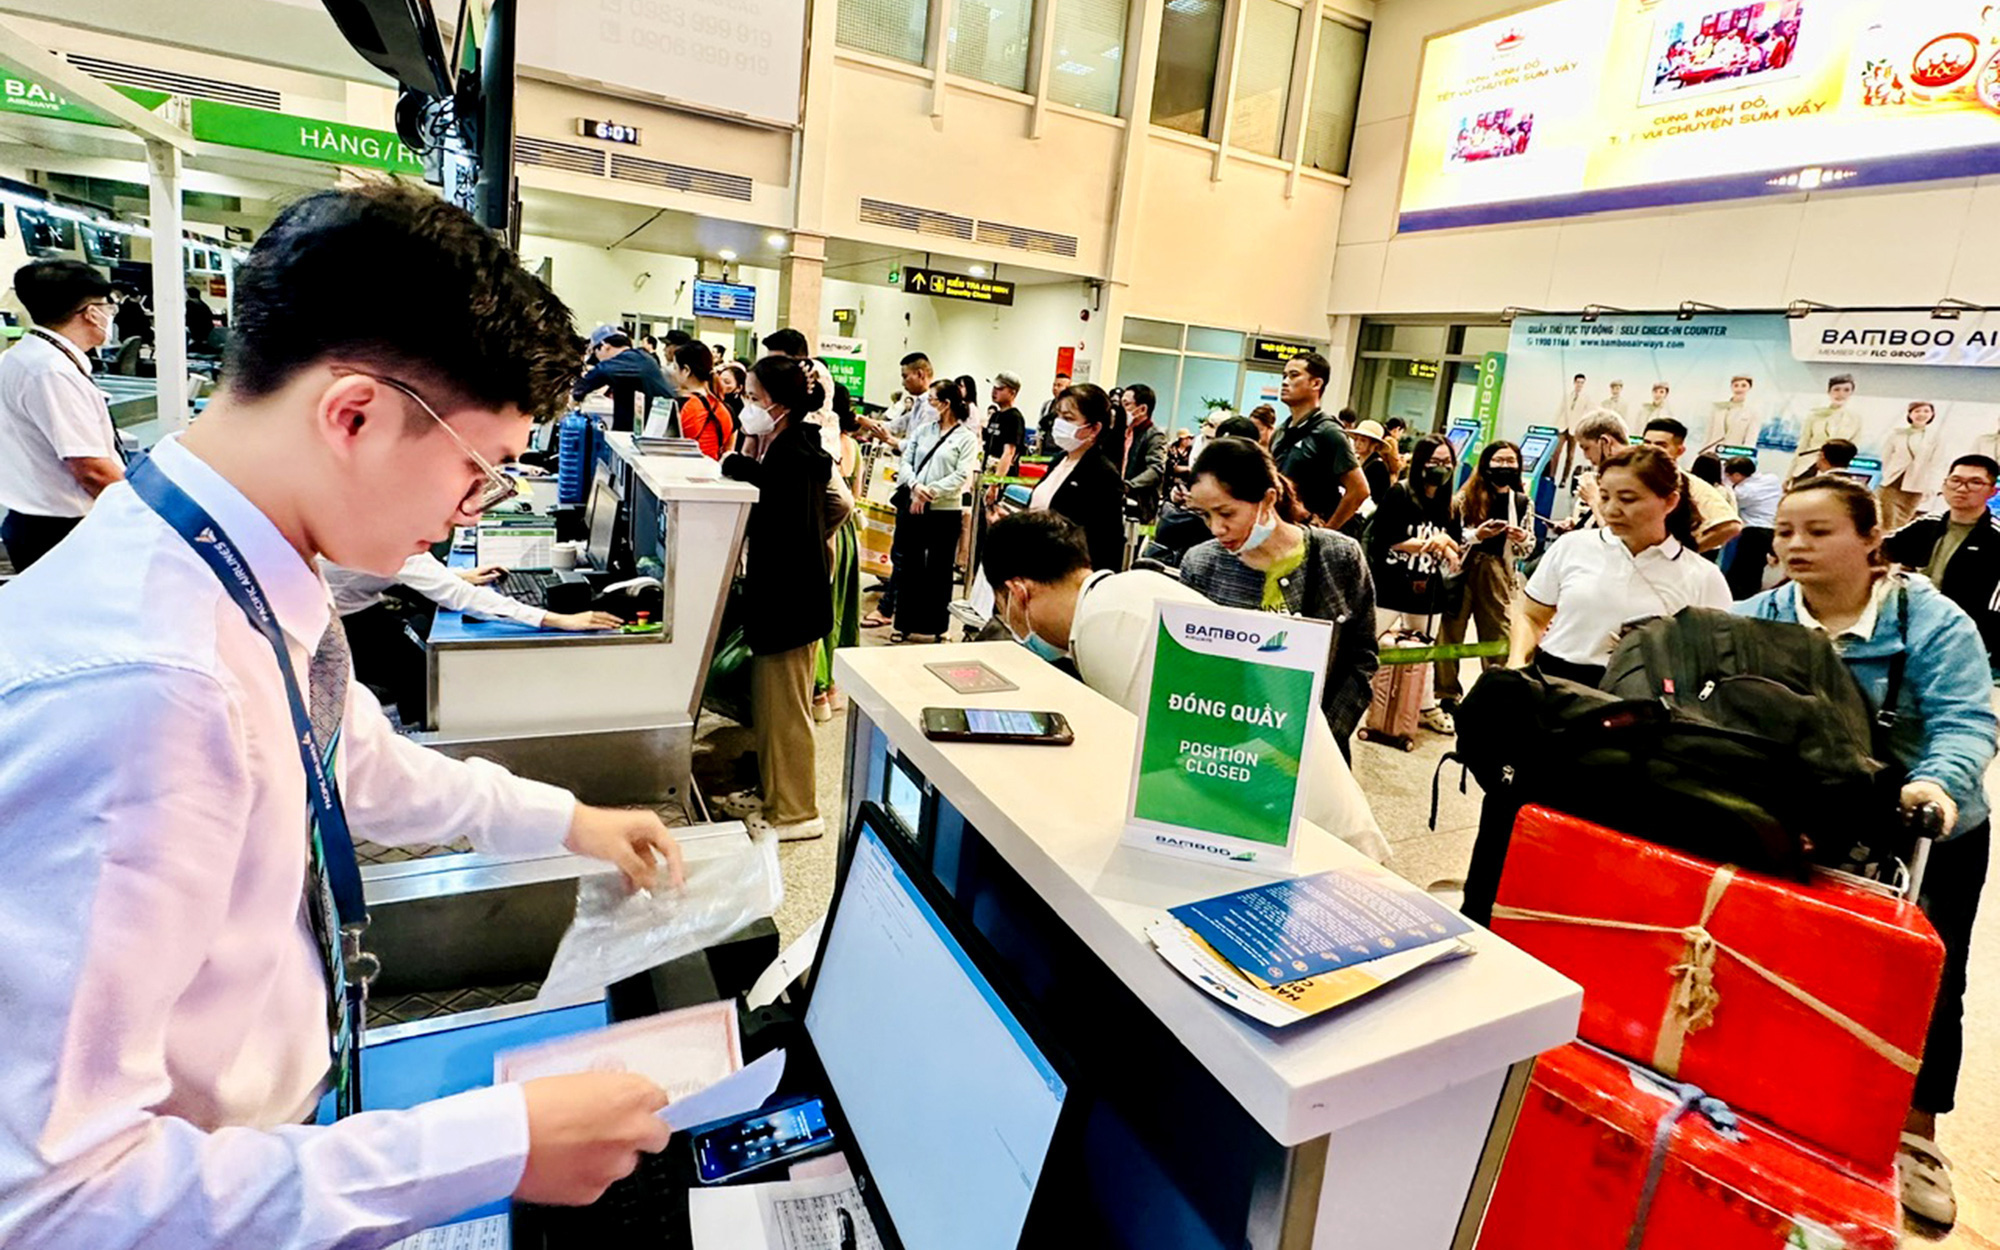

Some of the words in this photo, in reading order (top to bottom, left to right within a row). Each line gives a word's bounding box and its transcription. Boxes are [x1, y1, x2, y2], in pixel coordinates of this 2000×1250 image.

[1694, 103, 1734, 118] KINH
[1739, 109, 1779, 124] SUM
[1619, 326, 1640, 336] SELF
[1641, 325, 1683, 336] CHECK-IN
[1683, 325, 1728, 337] COUNTER
[1821, 329, 1955, 347] BAMBOO
[1580, 338, 1685, 350] www.bambooairways.com
[1870, 350, 1887, 358] FLC
[1890, 350, 1926, 358] GROUP
[214, 541, 251, 587] AIRLINES
[245, 587, 270, 622] PACIFIC
[1185, 623, 1261, 645] BAMBOO
[1168, 692, 1226, 718] ĐÓNG
[1231, 703, 1288, 729] QUẦY
[1179, 740, 1259, 767] POSITION
[1185, 758, 1251, 783] CLOSED
[1155, 835, 1231, 857] BAMBOO
